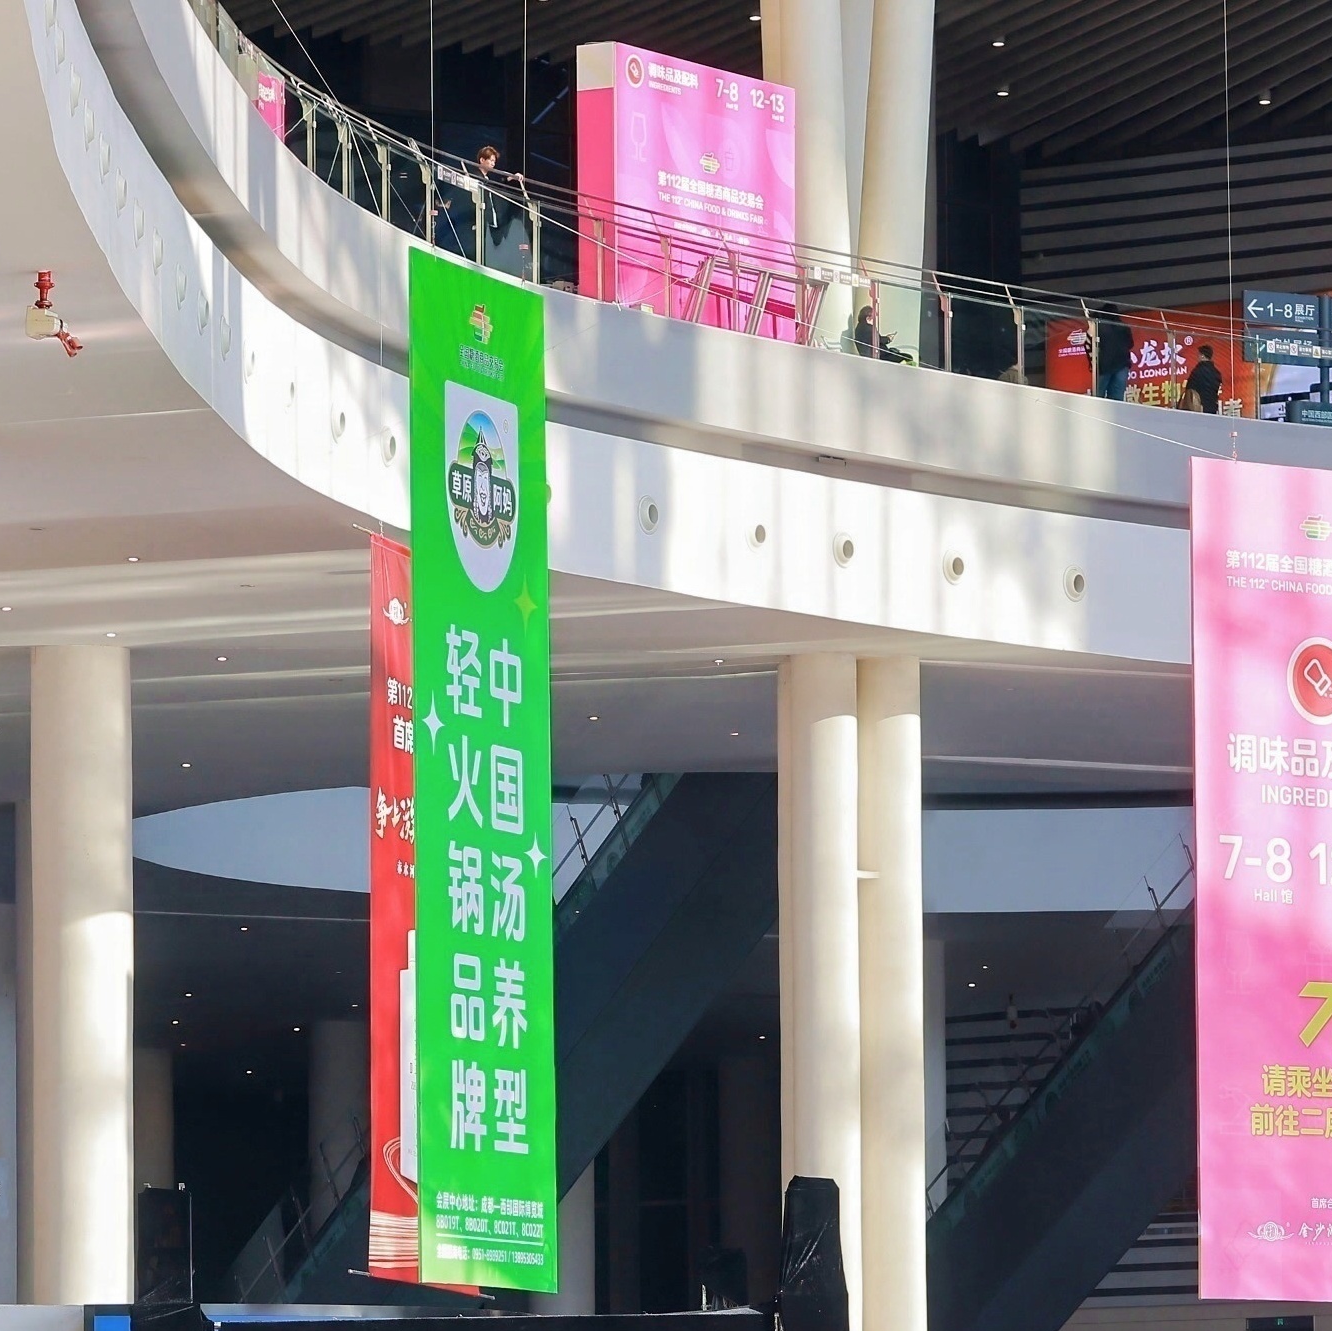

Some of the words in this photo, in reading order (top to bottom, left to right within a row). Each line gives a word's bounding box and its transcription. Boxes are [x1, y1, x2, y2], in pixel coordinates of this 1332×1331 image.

[648, 61, 699, 89] 调味品及配料
[716, 78, 739, 102] 7-8
[750, 88, 786, 114] 12-13
[657, 170, 765, 211] 第112届全国糖酒商品交易会
[658, 191, 672, 203] THE
[683, 196, 704, 211] CHINA
[704, 201, 721, 215] FOOD
[727, 206, 750, 222] DRINKS
[750, 213, 764, 225] FAIR
[1266, 302, 1293, 319] 1-8
[1295, 303, 1315, 317] 展厅
[1139, 367, 1168, 380] LOONG
[451, 469, 473, 504] 草原
[493, 483, 513, 518] 阿妈
[1226, 575, 1247, 588] THE
[1271, 579, 1304, 594] CHINA
[1305, 582, 1332, 596] FOOD
[1218, 833, 1294, 884] 7-8
[445, 623, 488, 1153] 轻火锅品牌
[488, 637, 530, 1156] 中国汤养型
[1253, 887, 1278, 902] Hall
[1280, 888, 1294, 904] 馆
